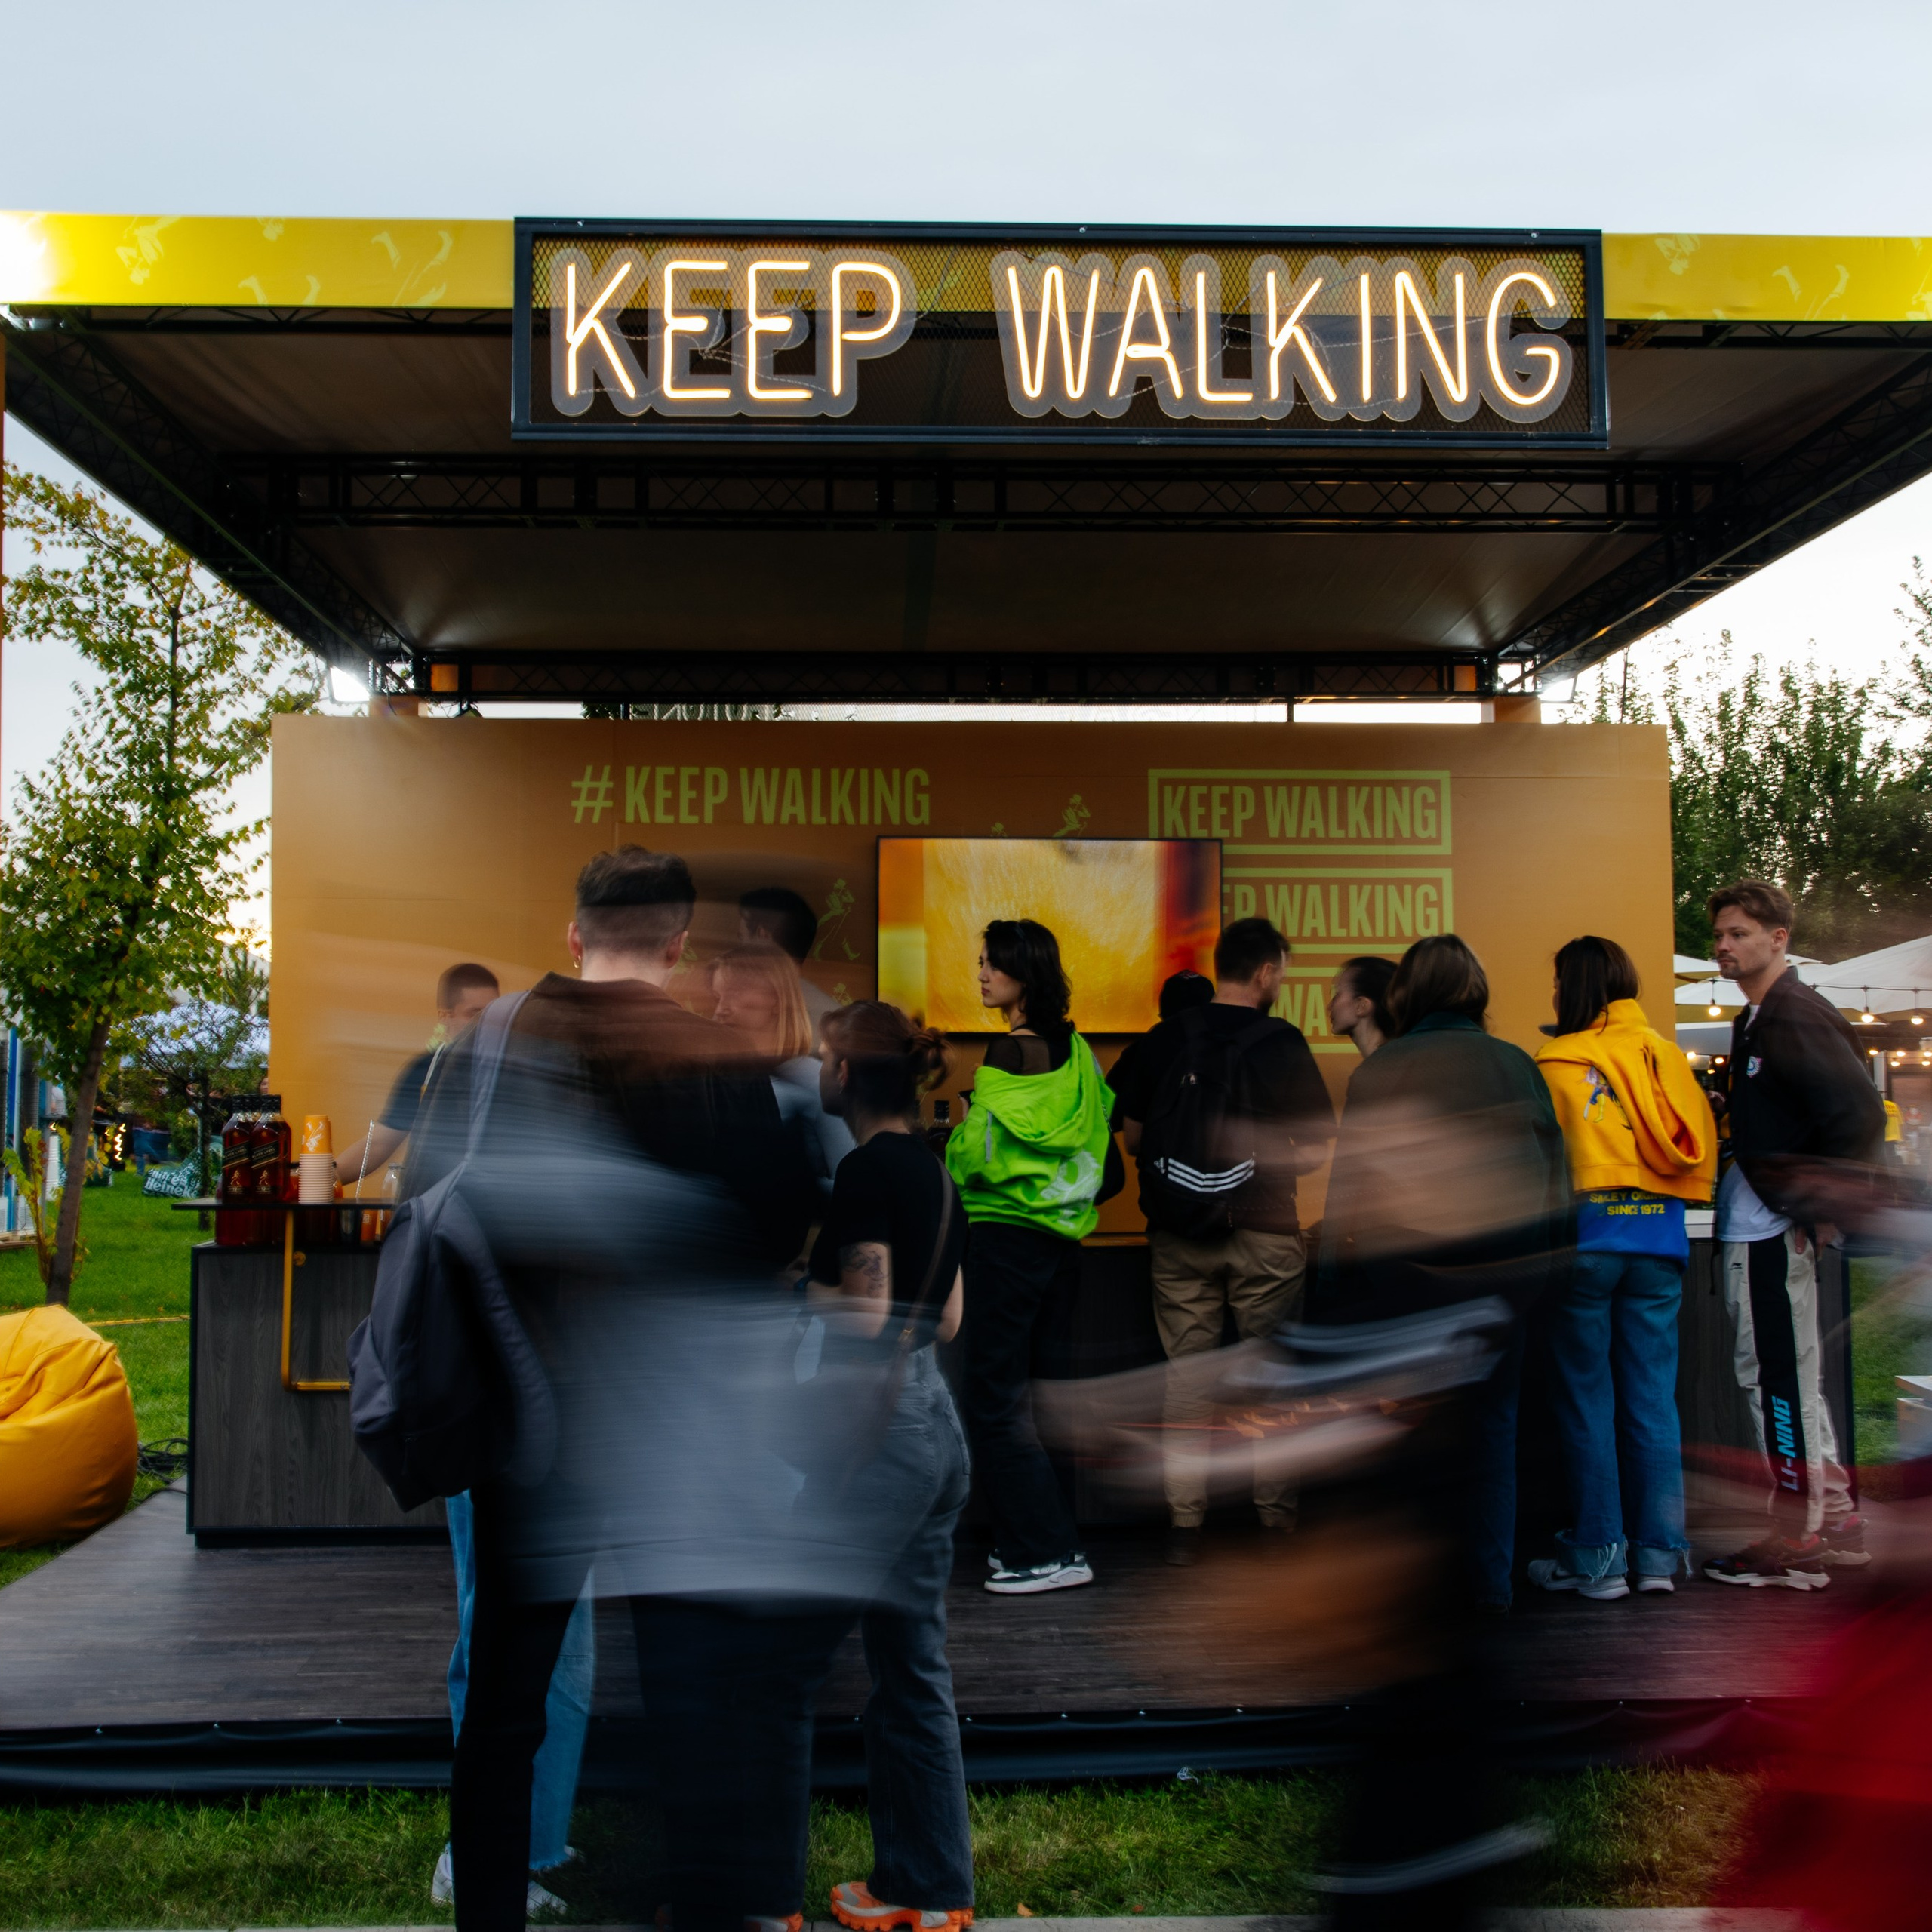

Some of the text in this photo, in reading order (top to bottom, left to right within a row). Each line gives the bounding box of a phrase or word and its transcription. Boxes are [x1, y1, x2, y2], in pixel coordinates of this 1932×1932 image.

[565, 260, 1561, 407] KEEP WALKING
[625, 765, 729, 824] KEEP
[739, 767, 931, 826] WALKING
[1162, 786, 1437, 838] KEEP WALKING
[1265, 884, 1438, 937] WALKING
[1641, 1204, 1666, 1214] 1972
[1772, 1396, 1799, 1491] LI-NING
